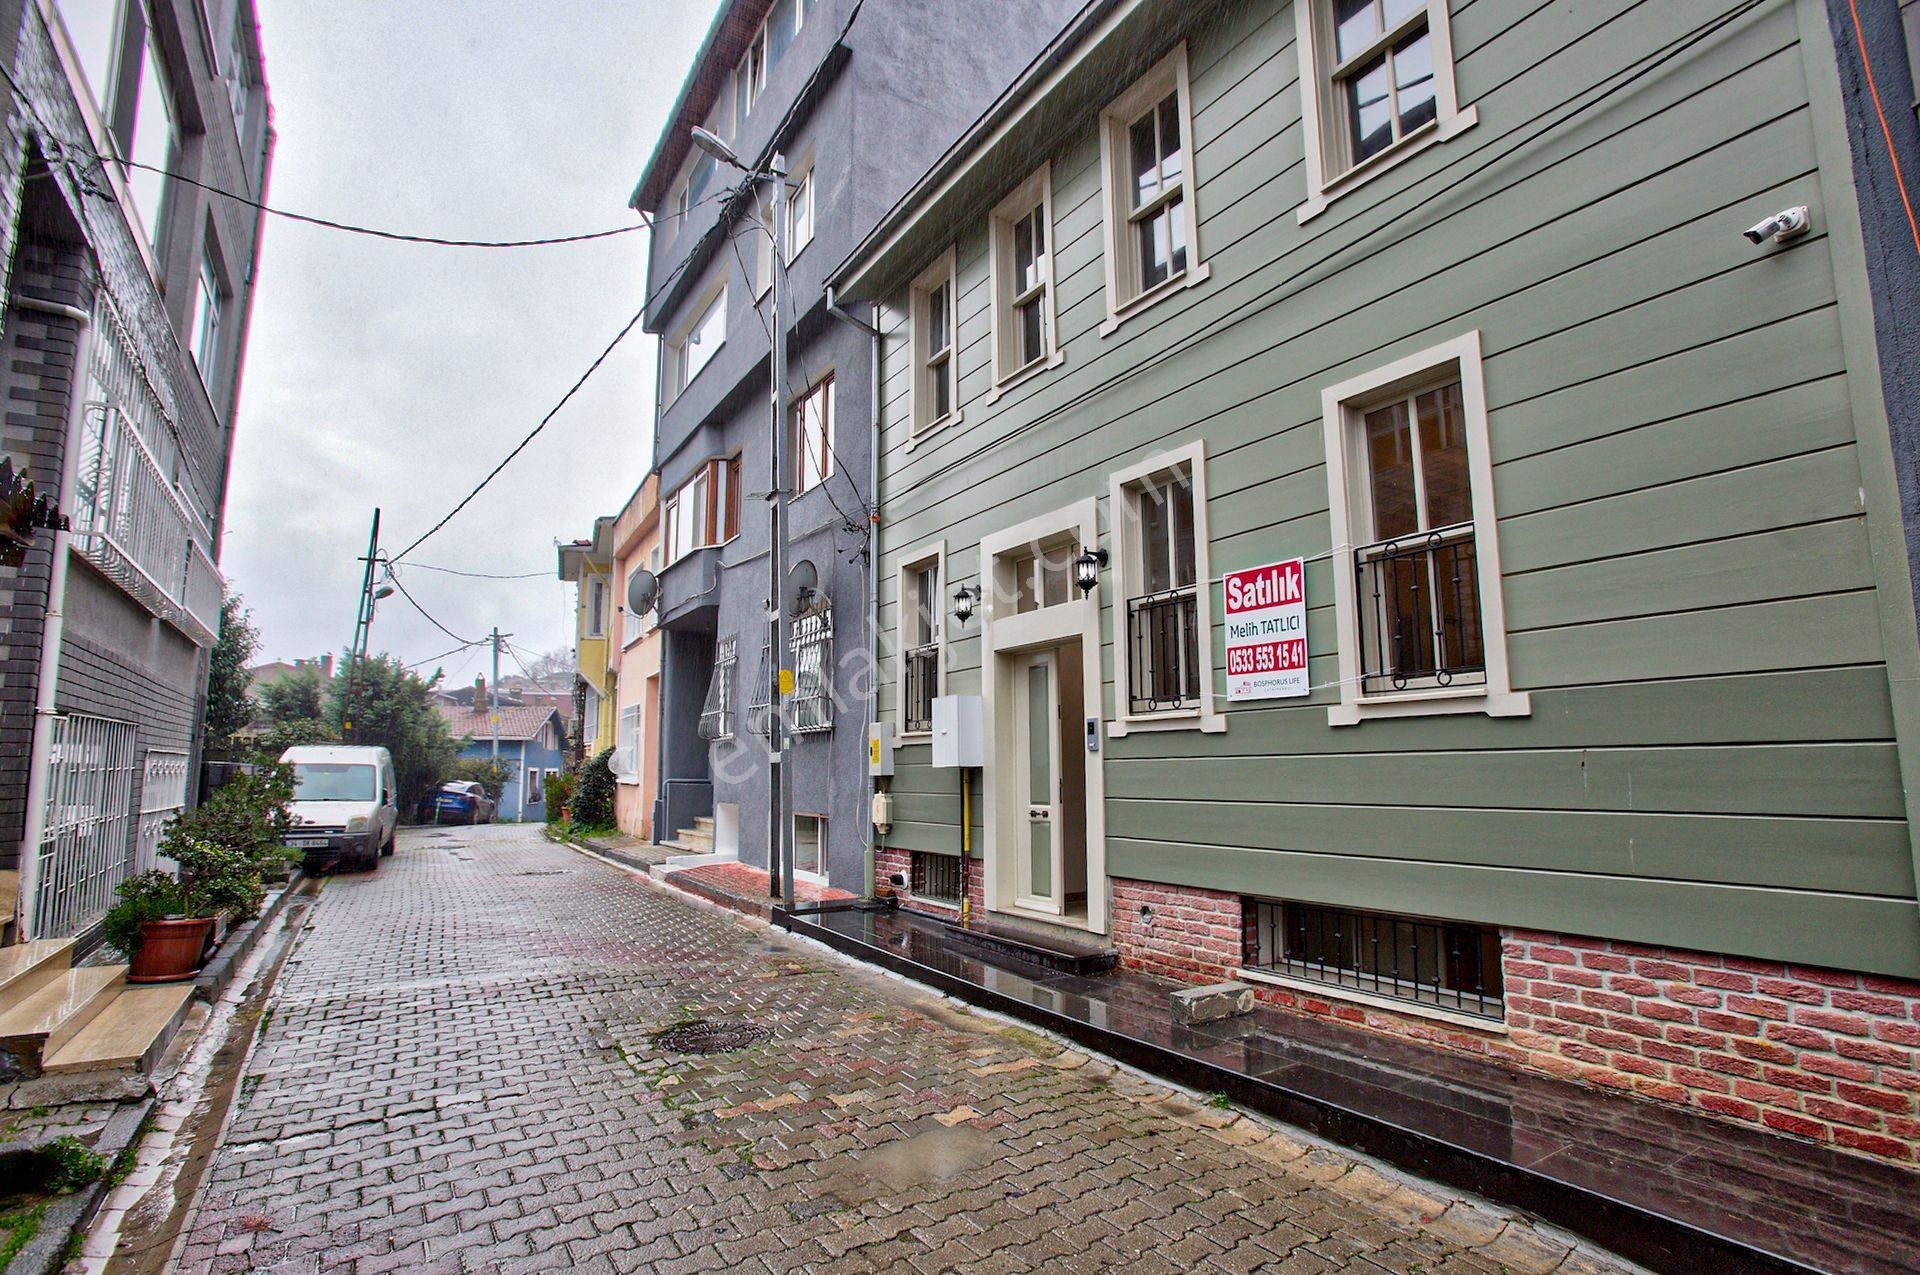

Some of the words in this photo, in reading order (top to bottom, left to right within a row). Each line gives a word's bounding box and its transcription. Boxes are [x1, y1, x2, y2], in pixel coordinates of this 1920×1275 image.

[1228, 566, 1301, 610] Satılık
[1230, 622, 1258, 638] Melih
[1260, 615, 1300, 634] TATLICI
[1229, 648, 1254, 673] 0533
[1256, 645, 1275, 671] 553
[1277, 643, 1289, 668] 15
[1291, 641, 1304, 666] 41
[1253, 678, 1288, 688] BOSPHORUS
[1289, 676, 1300, 684] LIFE
